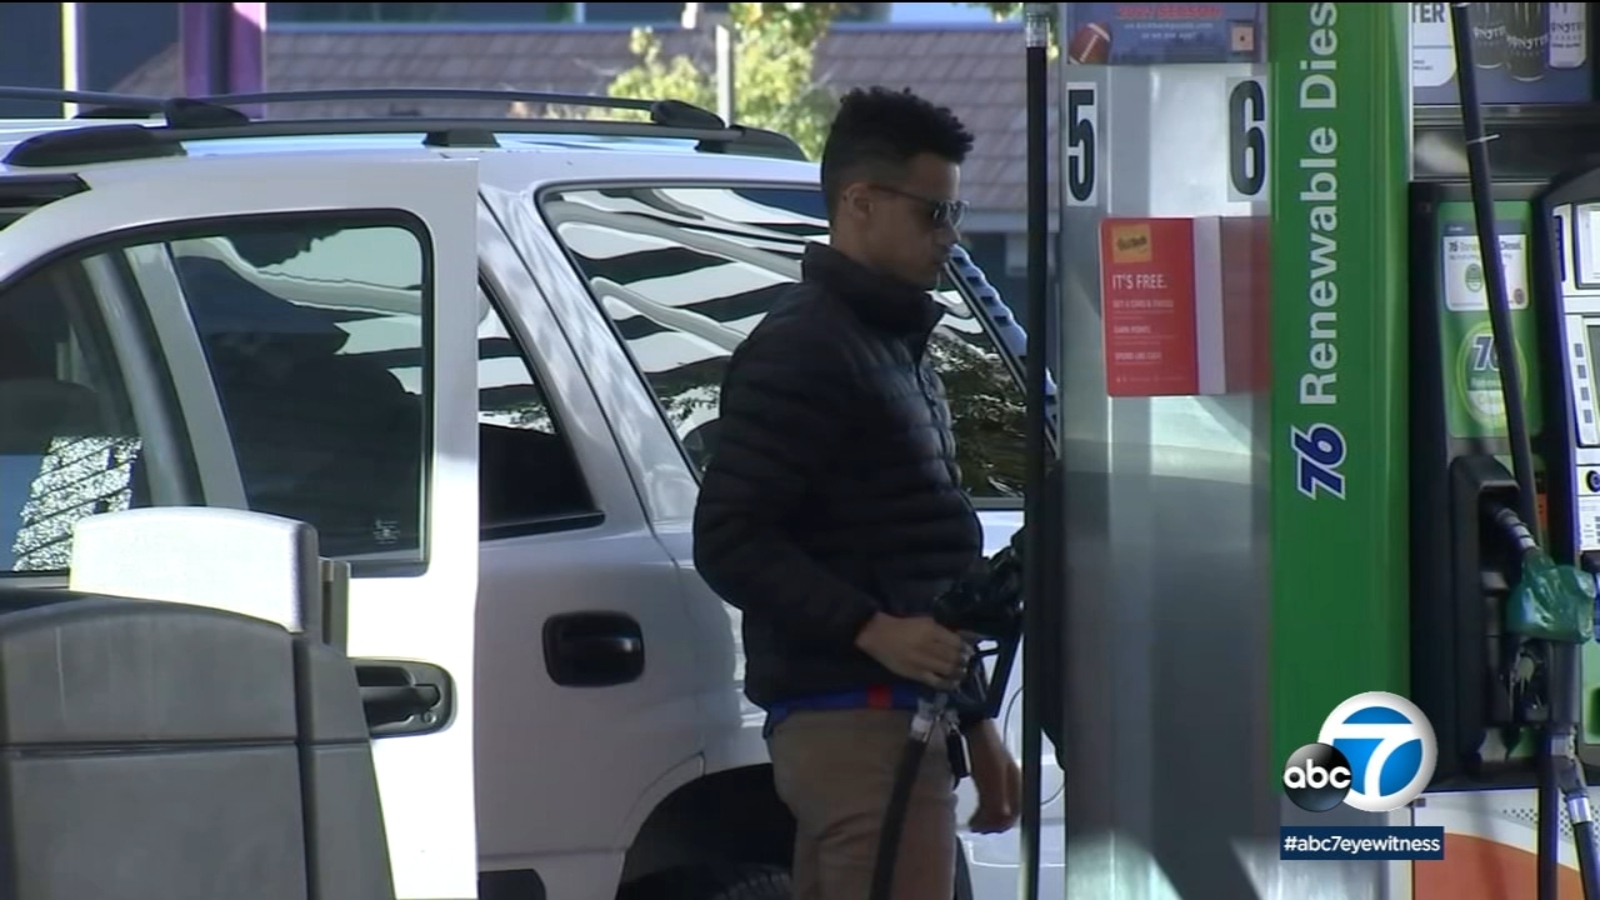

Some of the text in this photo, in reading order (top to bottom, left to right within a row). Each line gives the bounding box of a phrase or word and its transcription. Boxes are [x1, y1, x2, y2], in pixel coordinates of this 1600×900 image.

[1068, 89, 1095, 201] 5
[1229, 80, 1265, 196] 6
[1112, 274, 1168, 290] IT'S FREE.
[1291, 3, 1347, 500] 76 Renewable Dies
